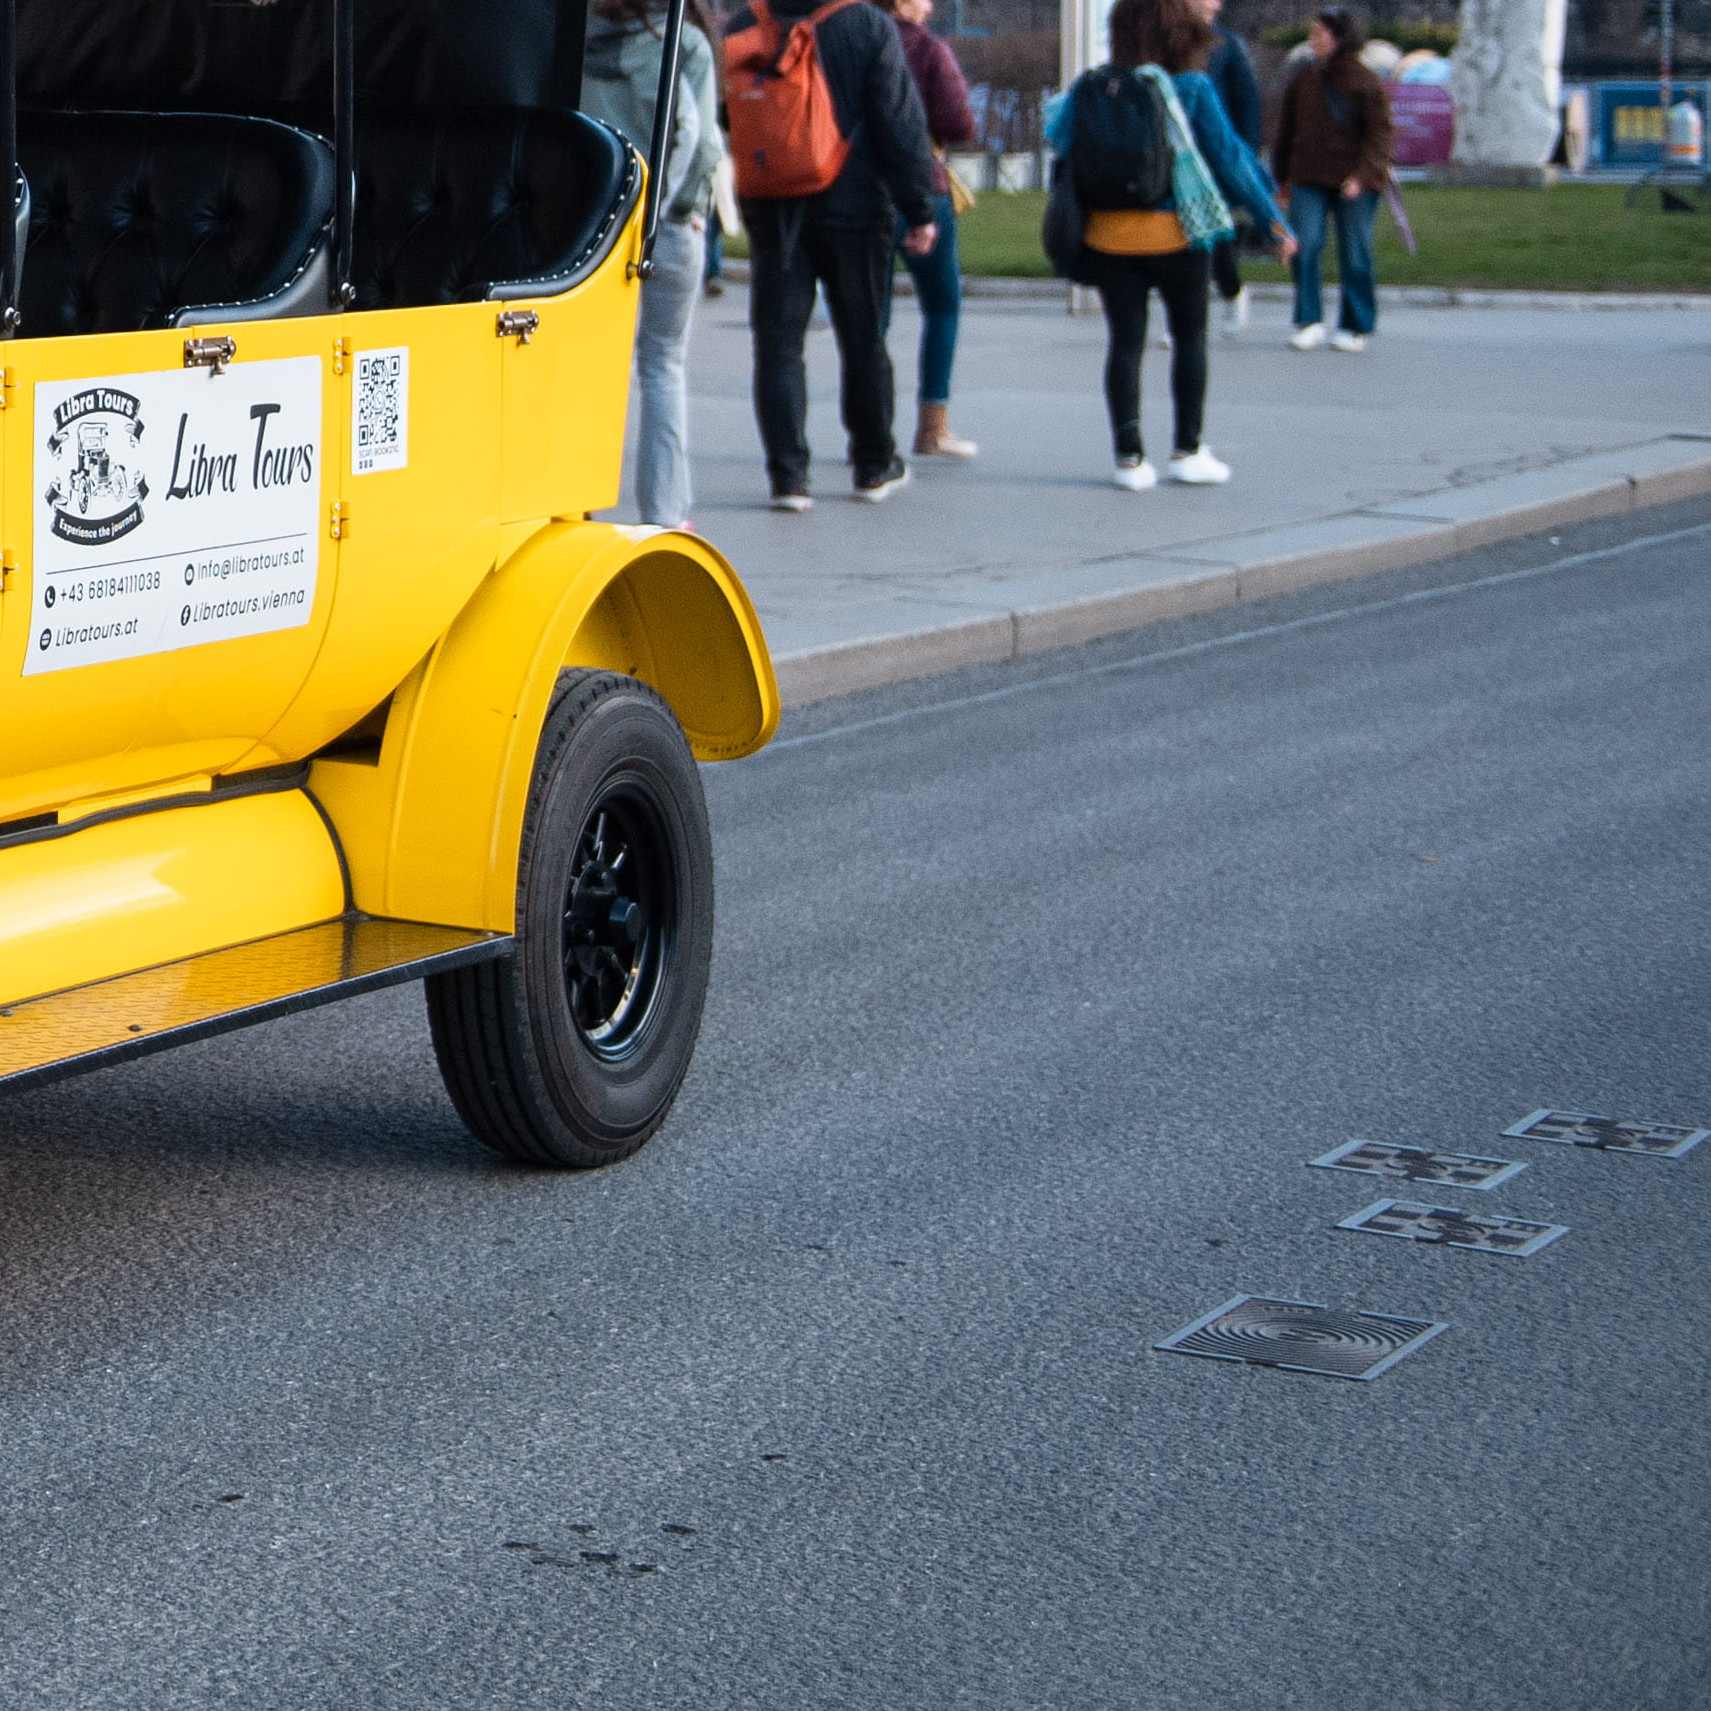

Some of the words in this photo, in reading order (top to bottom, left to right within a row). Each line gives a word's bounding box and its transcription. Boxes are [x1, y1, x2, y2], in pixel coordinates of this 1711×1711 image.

[59, 394, 94, 422] Libra
[97, 389, 135, 415] Tours
[165, 412, 239, 501] Libra
[250, 403, 314, 490] Tours
[58, 517, 97, 539] Experience
[98, 527, 111, 539] the
[110, 510, 139, 537] journey
[60, 582, 84, 603] +43
[88, 570, 161, 600] 68184111038
[193, 587, 305, 624] Libratours.vienna
[55, 617, 139, 648] Libratours.at
